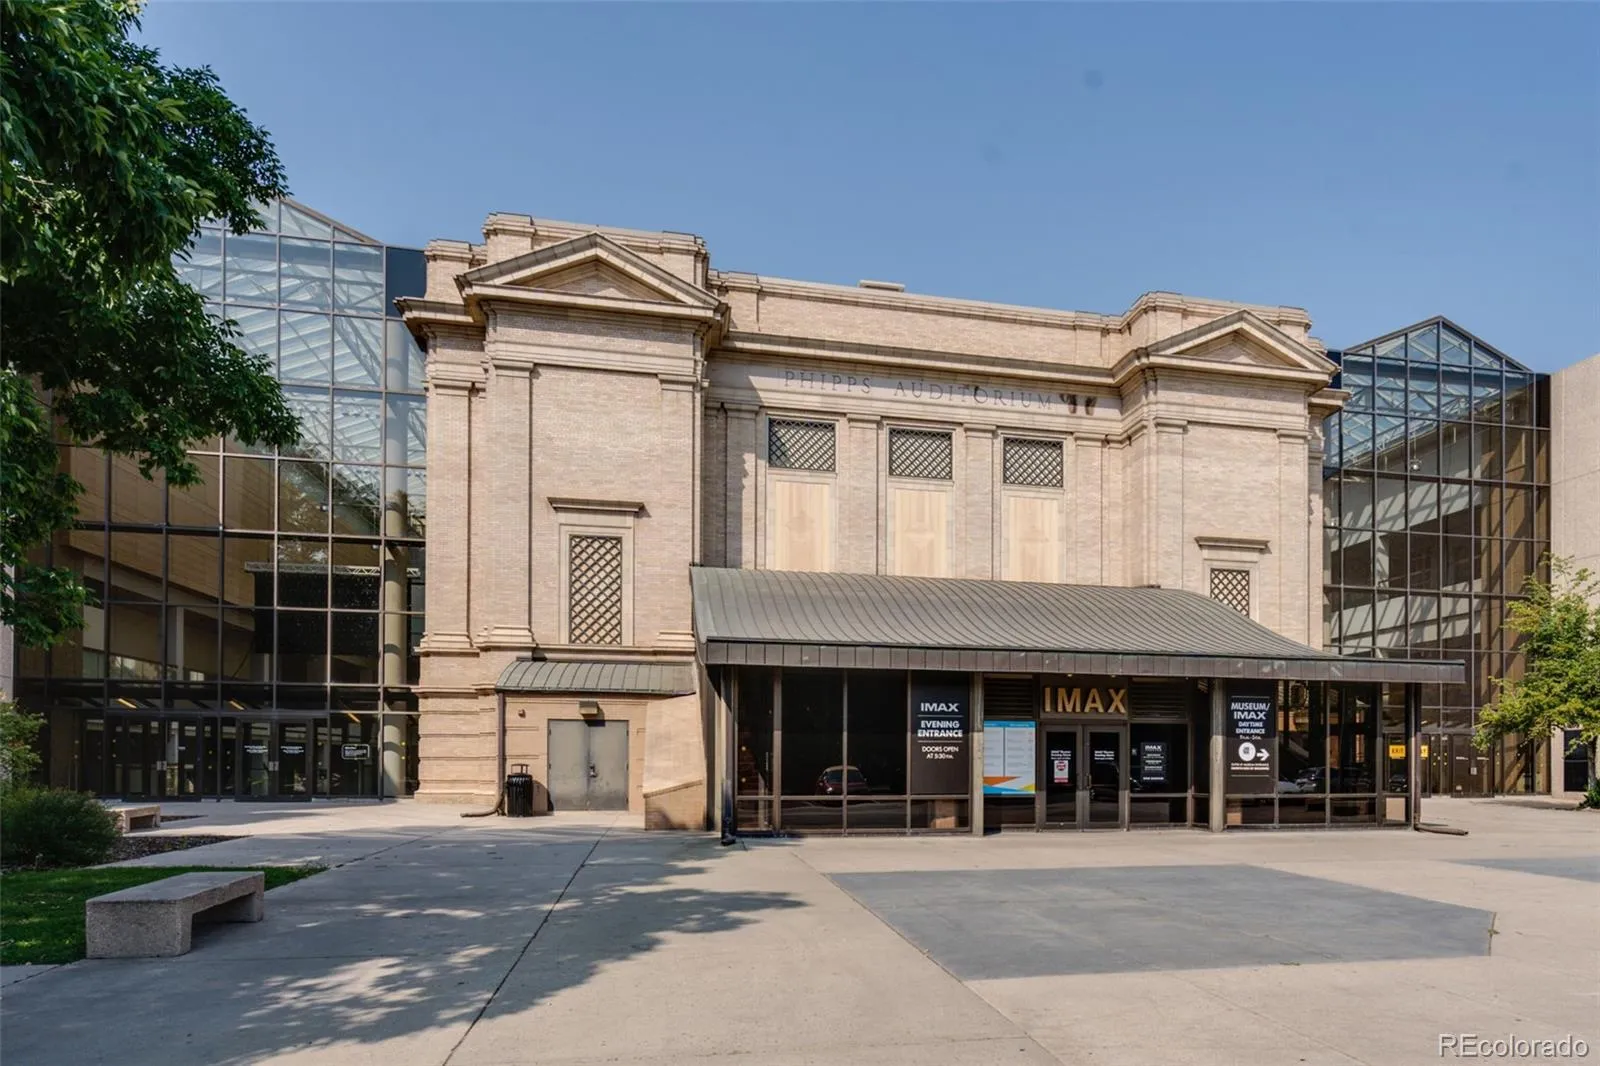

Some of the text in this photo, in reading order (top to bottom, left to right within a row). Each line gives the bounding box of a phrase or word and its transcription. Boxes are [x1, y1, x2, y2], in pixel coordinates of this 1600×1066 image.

[784, 370, 1052, 410] PHIPPS AUDITORIUM
[1044, 687, 1127, 714] IMAX
[920, 702, 960, 712] IMAX
[1230, 702, 1271, 711] MUSEUM/
[1233, 711, 1266, 720] IMAX
[920, 720, 960, 729] EVENING
[917, 729, 963, 737] ENTRANCE
